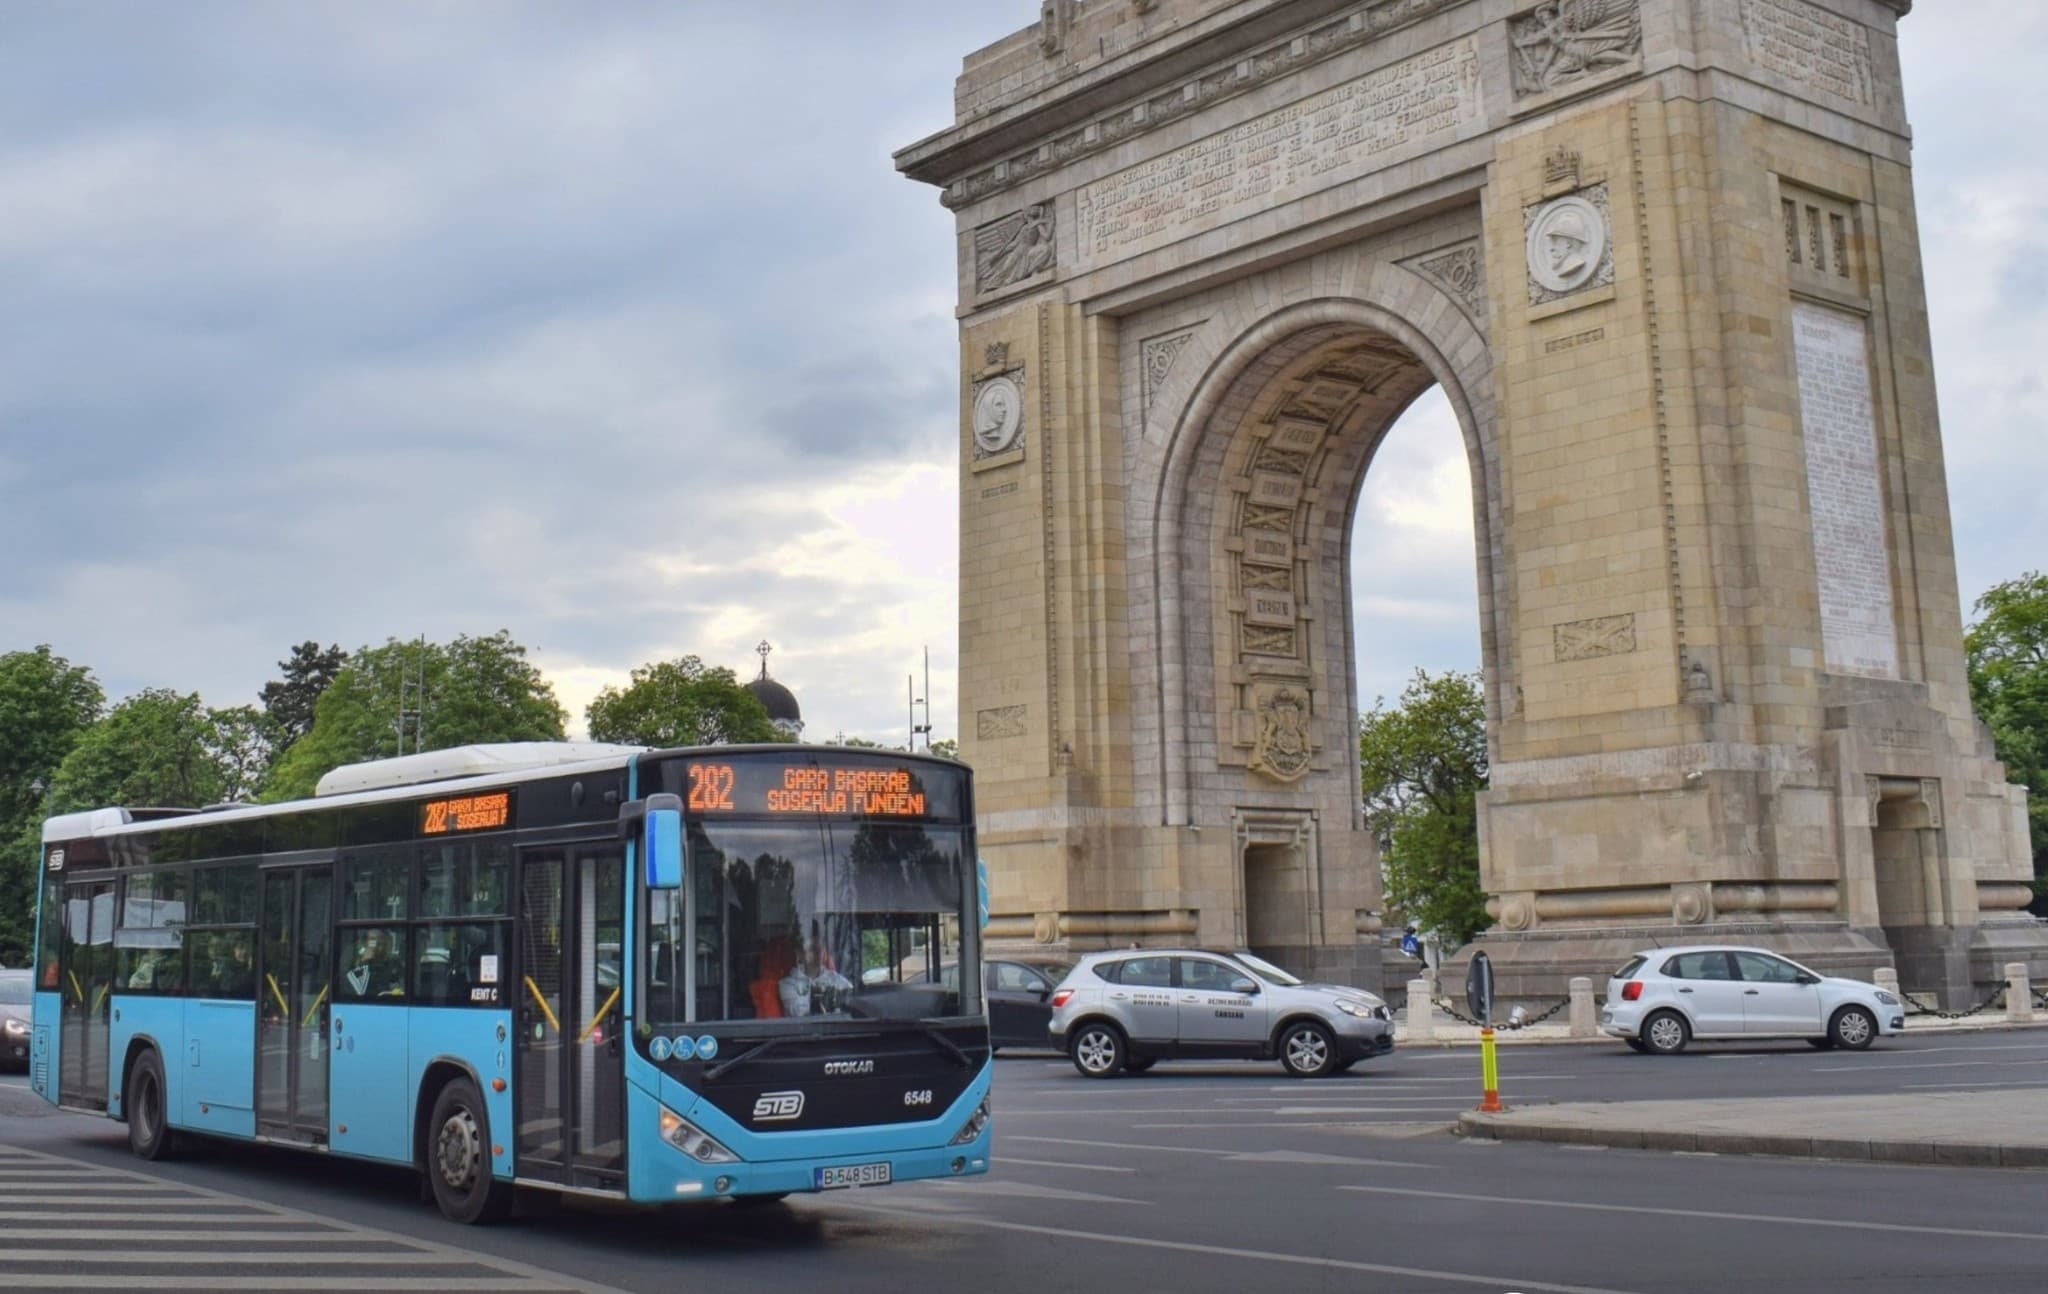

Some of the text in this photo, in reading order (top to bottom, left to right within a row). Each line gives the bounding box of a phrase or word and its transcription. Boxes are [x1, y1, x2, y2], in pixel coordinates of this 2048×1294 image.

[688, 764, 735, 810] 282
[784, 768, 911, 793] GARA BASARAB
[852, 793, 925, 815] FUNDENI
[424, 802, 447, 833] 282
[471, 988, 498, 1001] KENT C
[824, 1059, 874, 1075] OTOKAR
[753, 1094, 804, 1119] STB
[904, 1089, 933, 1105] 6548
